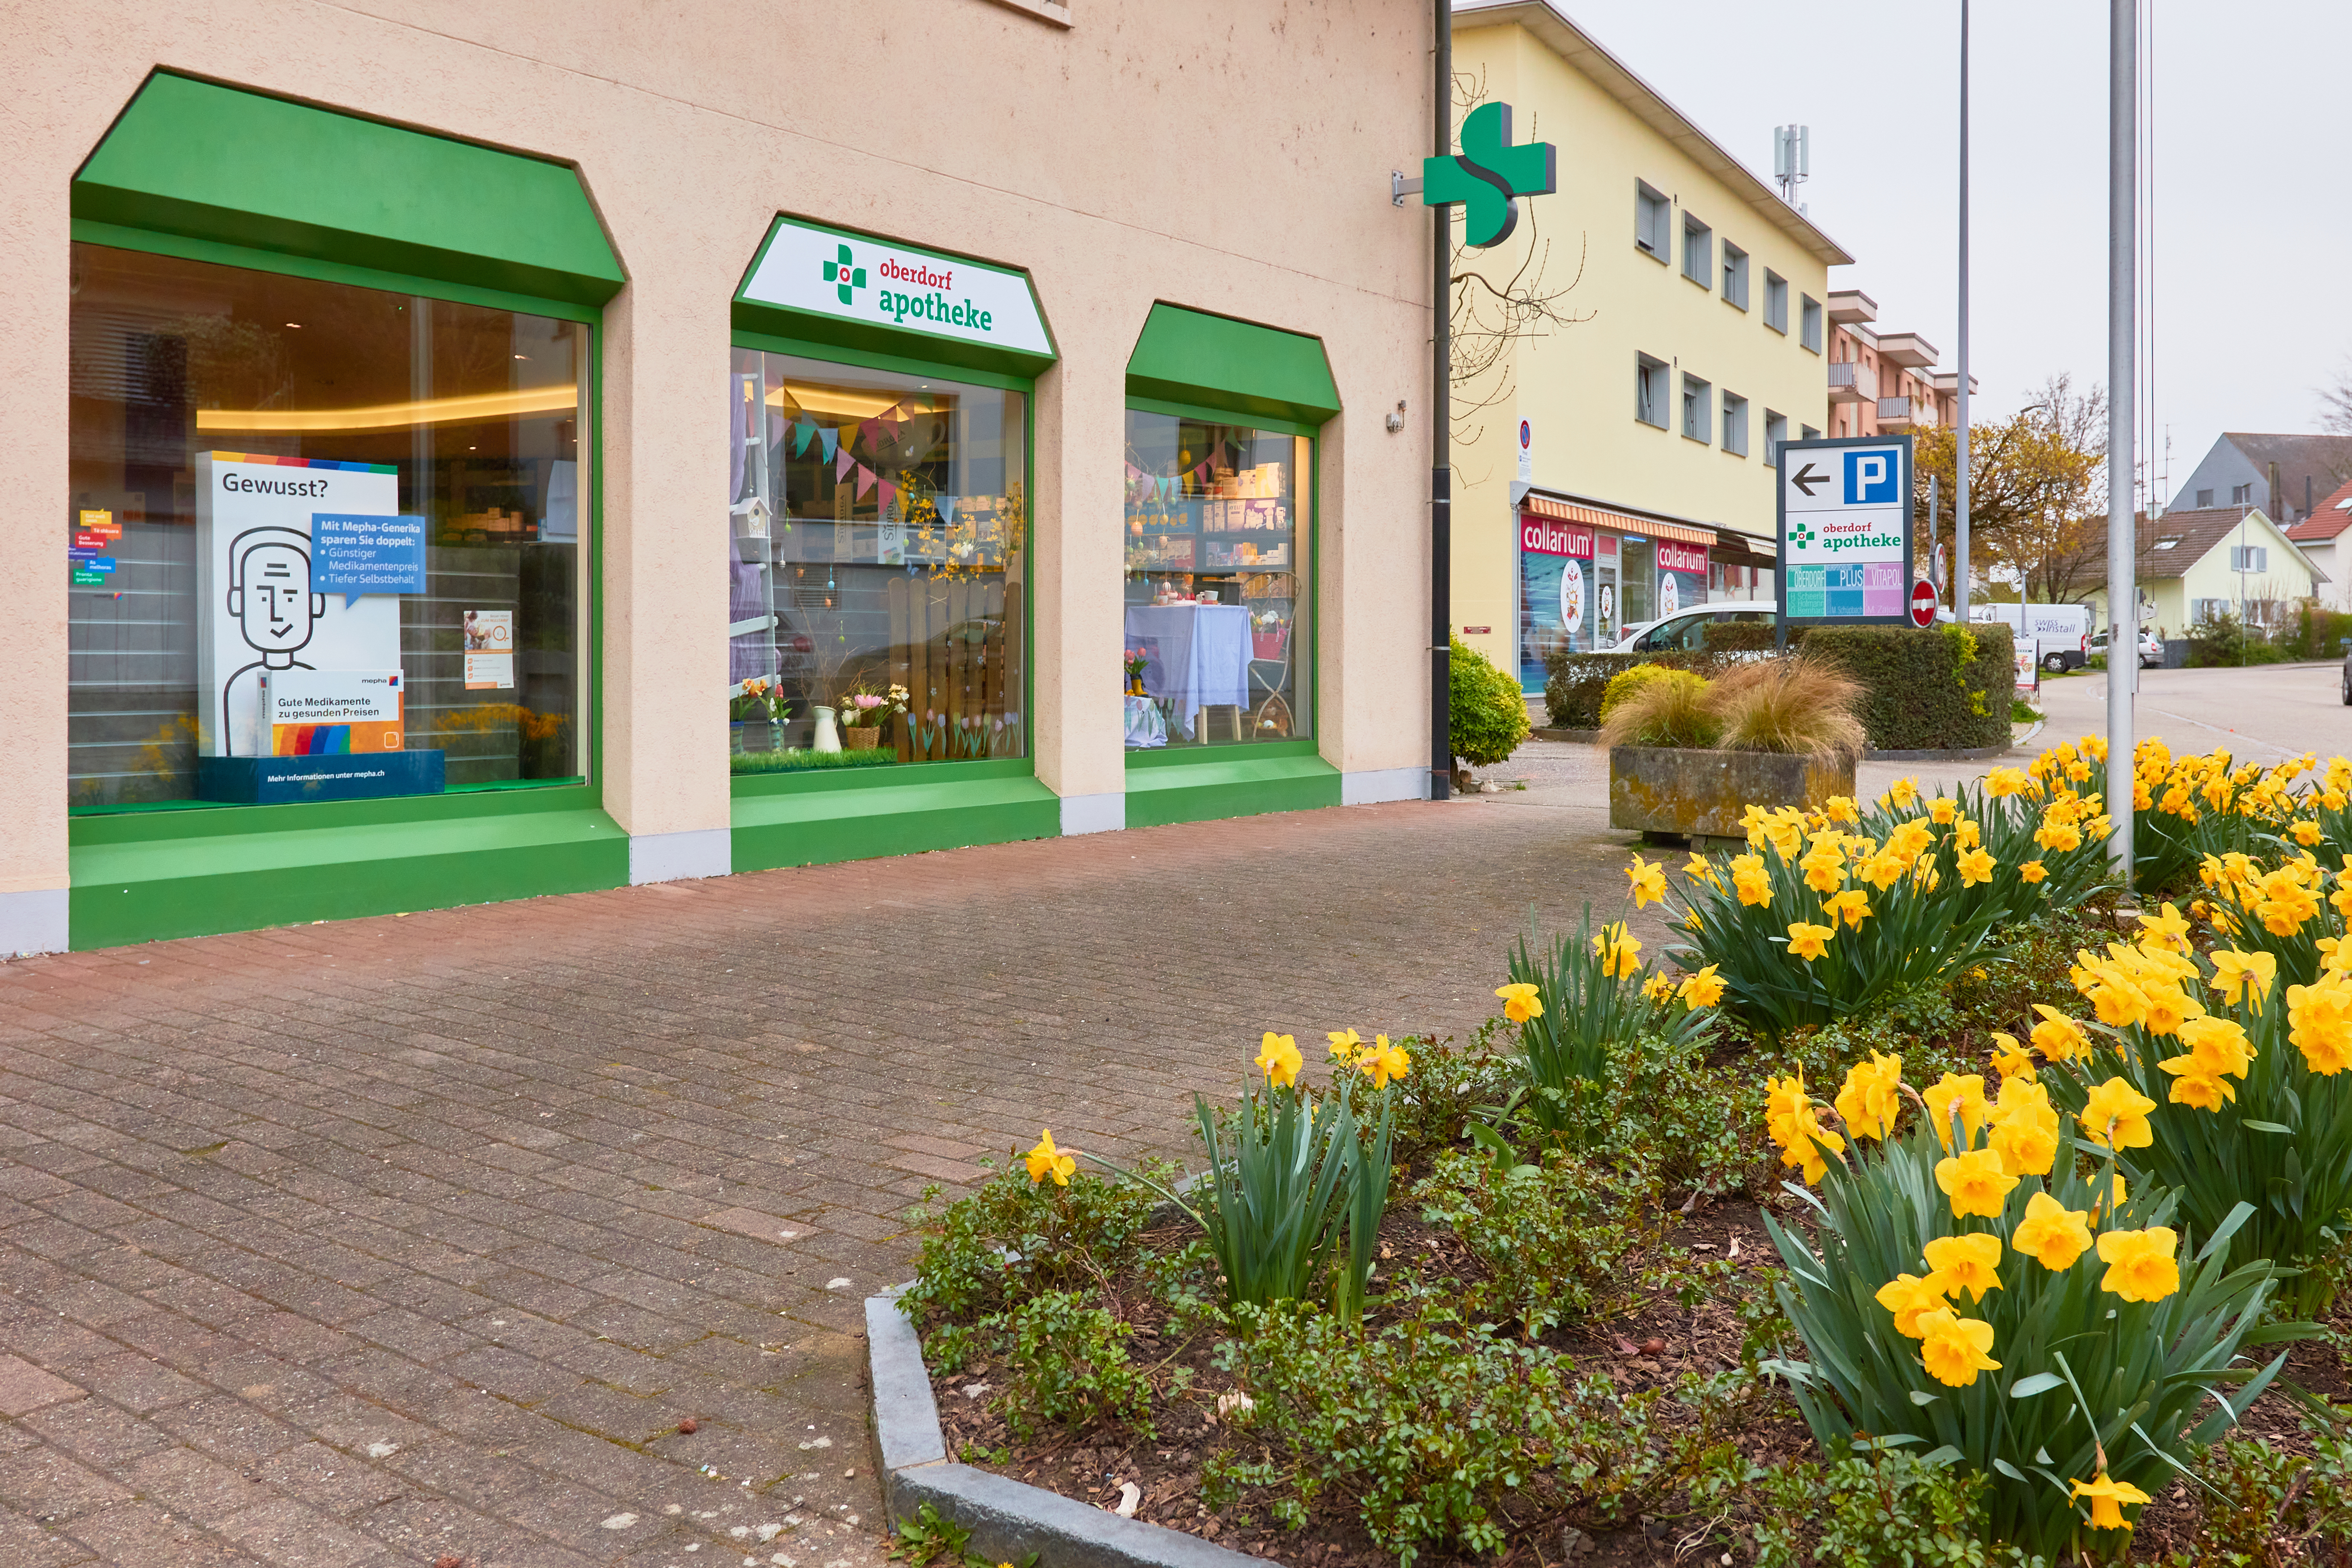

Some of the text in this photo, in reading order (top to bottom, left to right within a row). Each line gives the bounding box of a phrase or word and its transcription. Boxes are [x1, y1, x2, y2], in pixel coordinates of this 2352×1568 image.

[880, 258, 952, 290] oberdorf
[879, 290, 992, 331] apotheke
[222, 473, 329, 498] Gewusst?
[1857, 456, 1886, 501] P
[321, 521, 421, 534] Mit Mepha-Generika
[884, 499, 894, 541] SIDRO
[1823, 522, 1872, 533] oberdorf
[321, 536, 415, 548] sparen Sie doppelt:
[1823, 533, 1901, 552] apotheke
[329, 548, 376, 559] Günstiger
[329, 561, 419, 572] Medikamentenpreis
[329, 574, 415, 584] Tiefer Selbstbehalt
[1794, 571, 1825, 588] OBERDORF
[1840, 569, 1863, 587] PLUS
[1871, 568, 1902, 586] VITAPOL
[278, 698, 371, 707] Gute Medikamente
[292, 709, 341, 719] gesunden
[343, 708, 379, 716] Preisen
[287, 773, 334, 781] Informationen
[354, 770, 385, 778] mepha.ch
